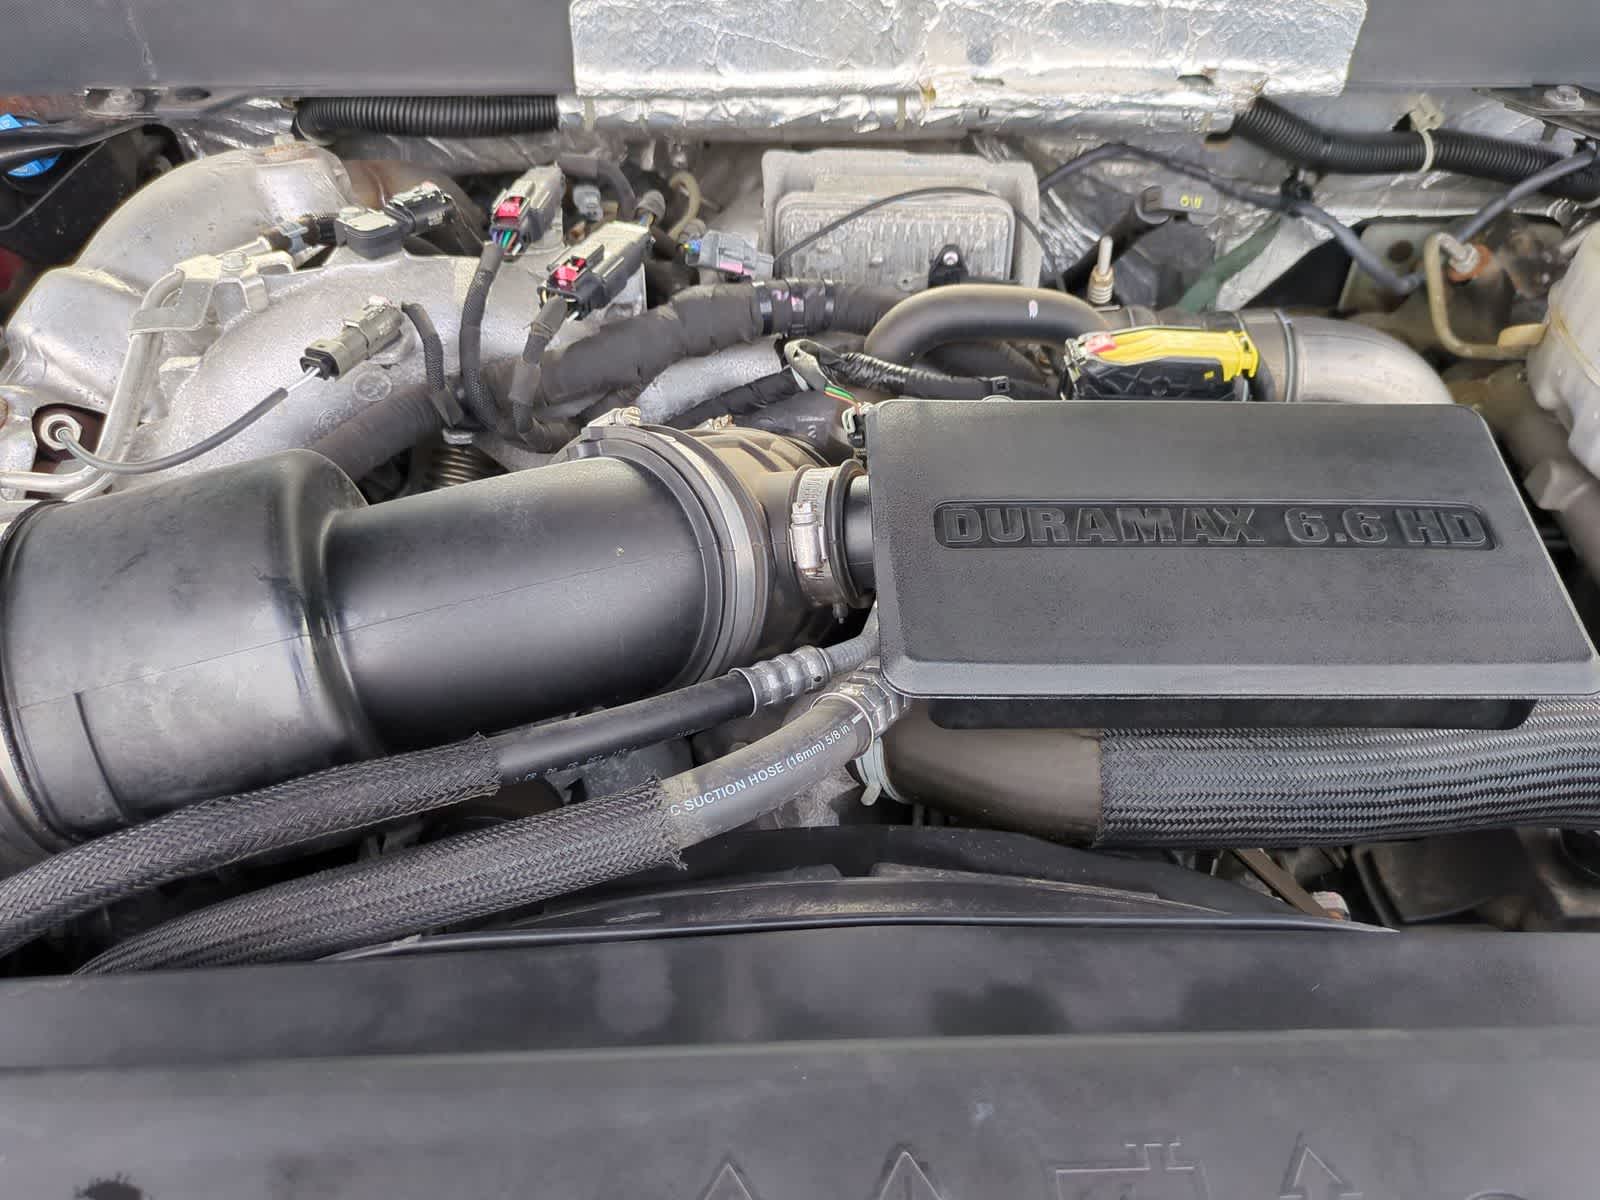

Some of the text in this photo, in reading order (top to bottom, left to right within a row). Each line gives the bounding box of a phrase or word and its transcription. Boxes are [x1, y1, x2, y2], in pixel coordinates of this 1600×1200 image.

[943, 505, 1490, 546] DURAMAX 6.6 HD
[684, 778, 746, 811] SUCTION
[749, 761, 785, 787] HOSE
[786, 741, 826, 770] (16mm)
[826, 730, 842, 746] 5/8
[839, 723, 850, 735] in
